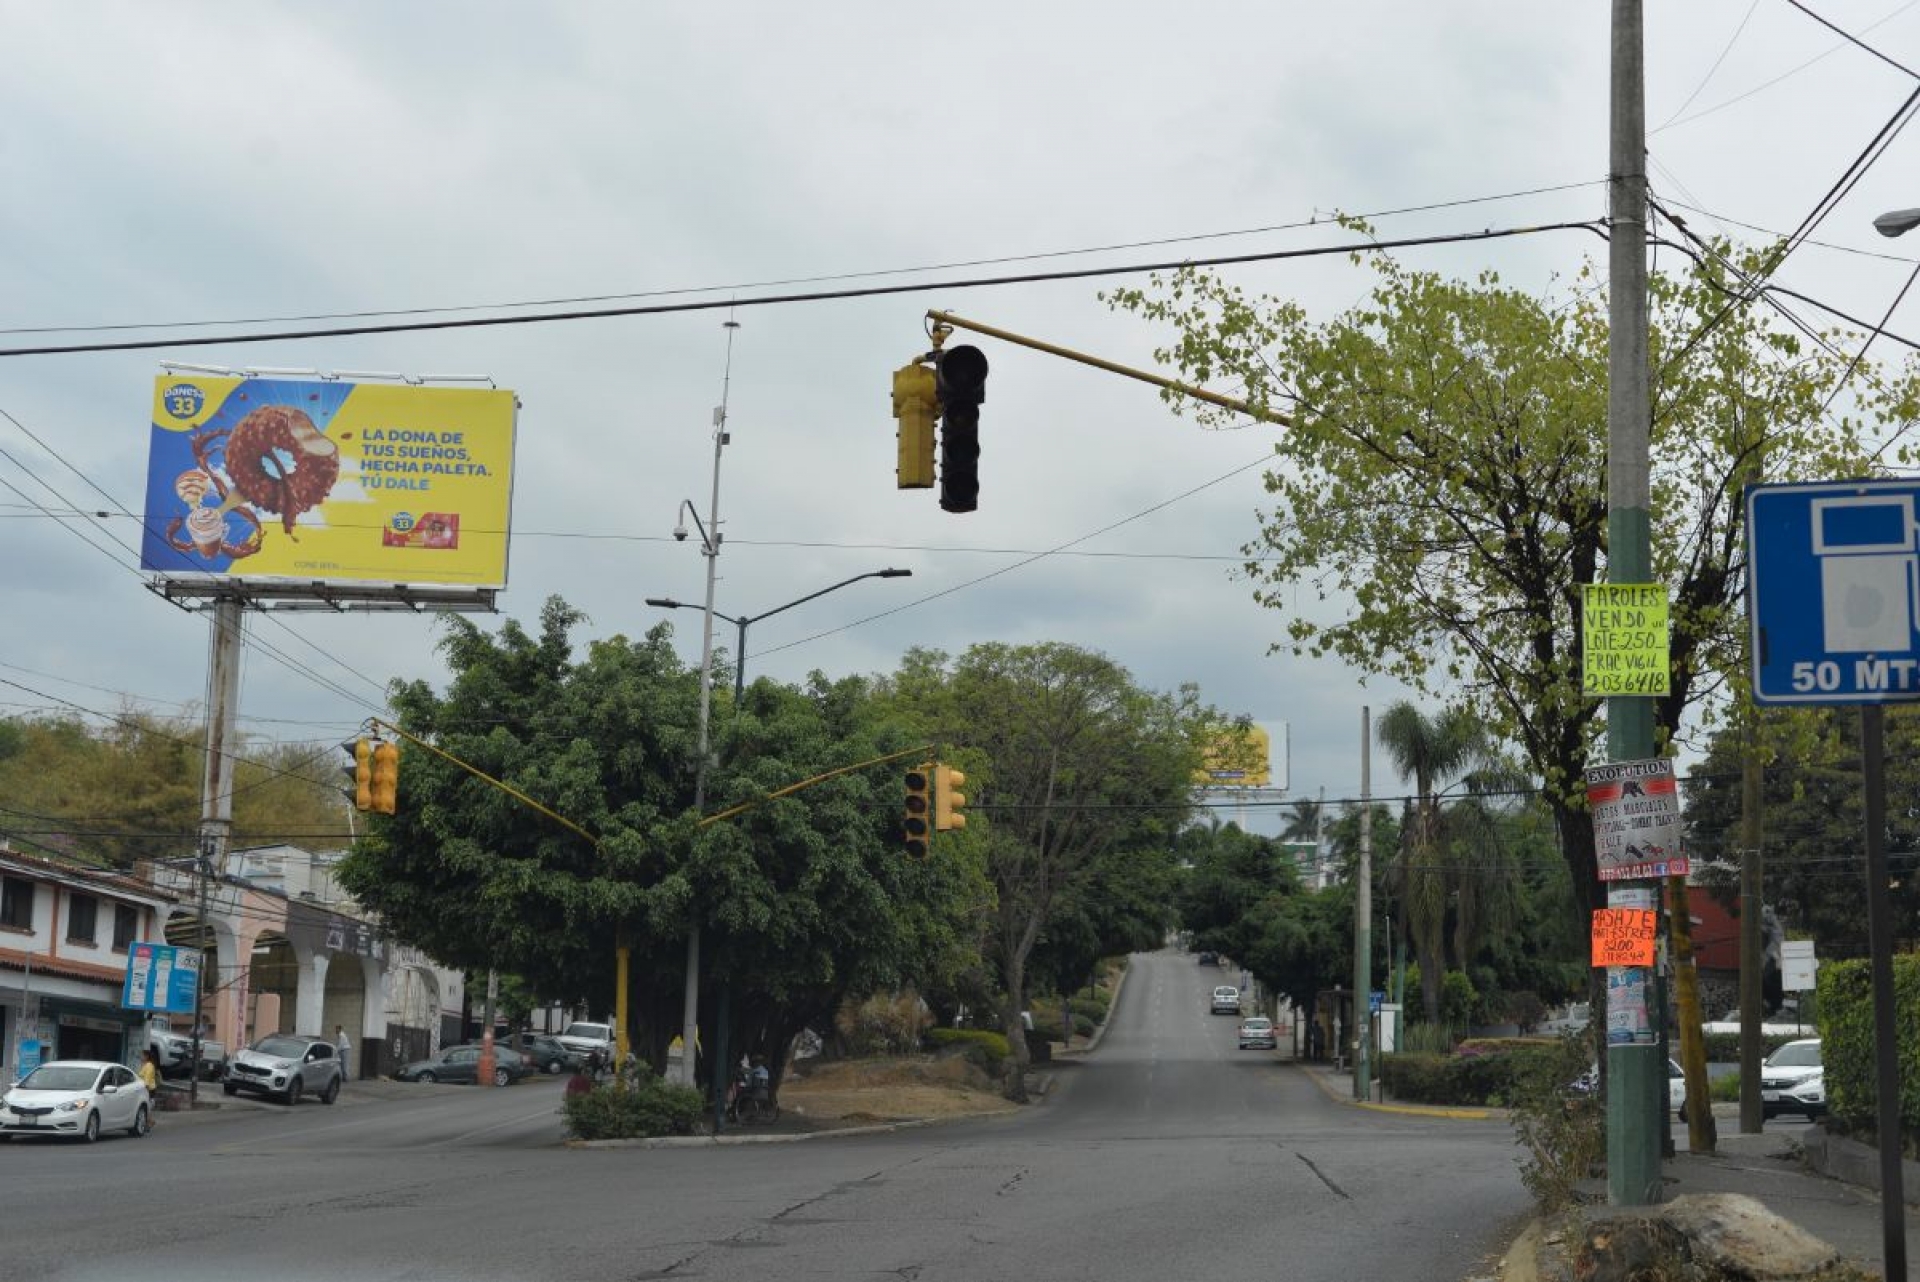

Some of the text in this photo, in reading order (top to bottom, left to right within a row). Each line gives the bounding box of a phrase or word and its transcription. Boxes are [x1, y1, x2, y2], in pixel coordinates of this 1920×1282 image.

[172, 396, 195, 415] 33
[362, 428, 464, 445] LA DONA DE
[361, 443, 471, 462] TUS SUEÑOS,
[361, 459, 493, 477] HECHA PALETA.
[359, 473, 431, 491] TÚ DALE
[1585, 586, 1659, 608] FAROLES
[1586, 610, 1646, 628] VENDO
[1586, 629, 1617, 651] LOTE
[1586, 653, 1621, 671] FRAC
[1792, 659, 1920, 693] 50 MT
[1588, 761, 1668, 782] EVOLUTION
[1593, 909, 1654, 928] MASAJE
